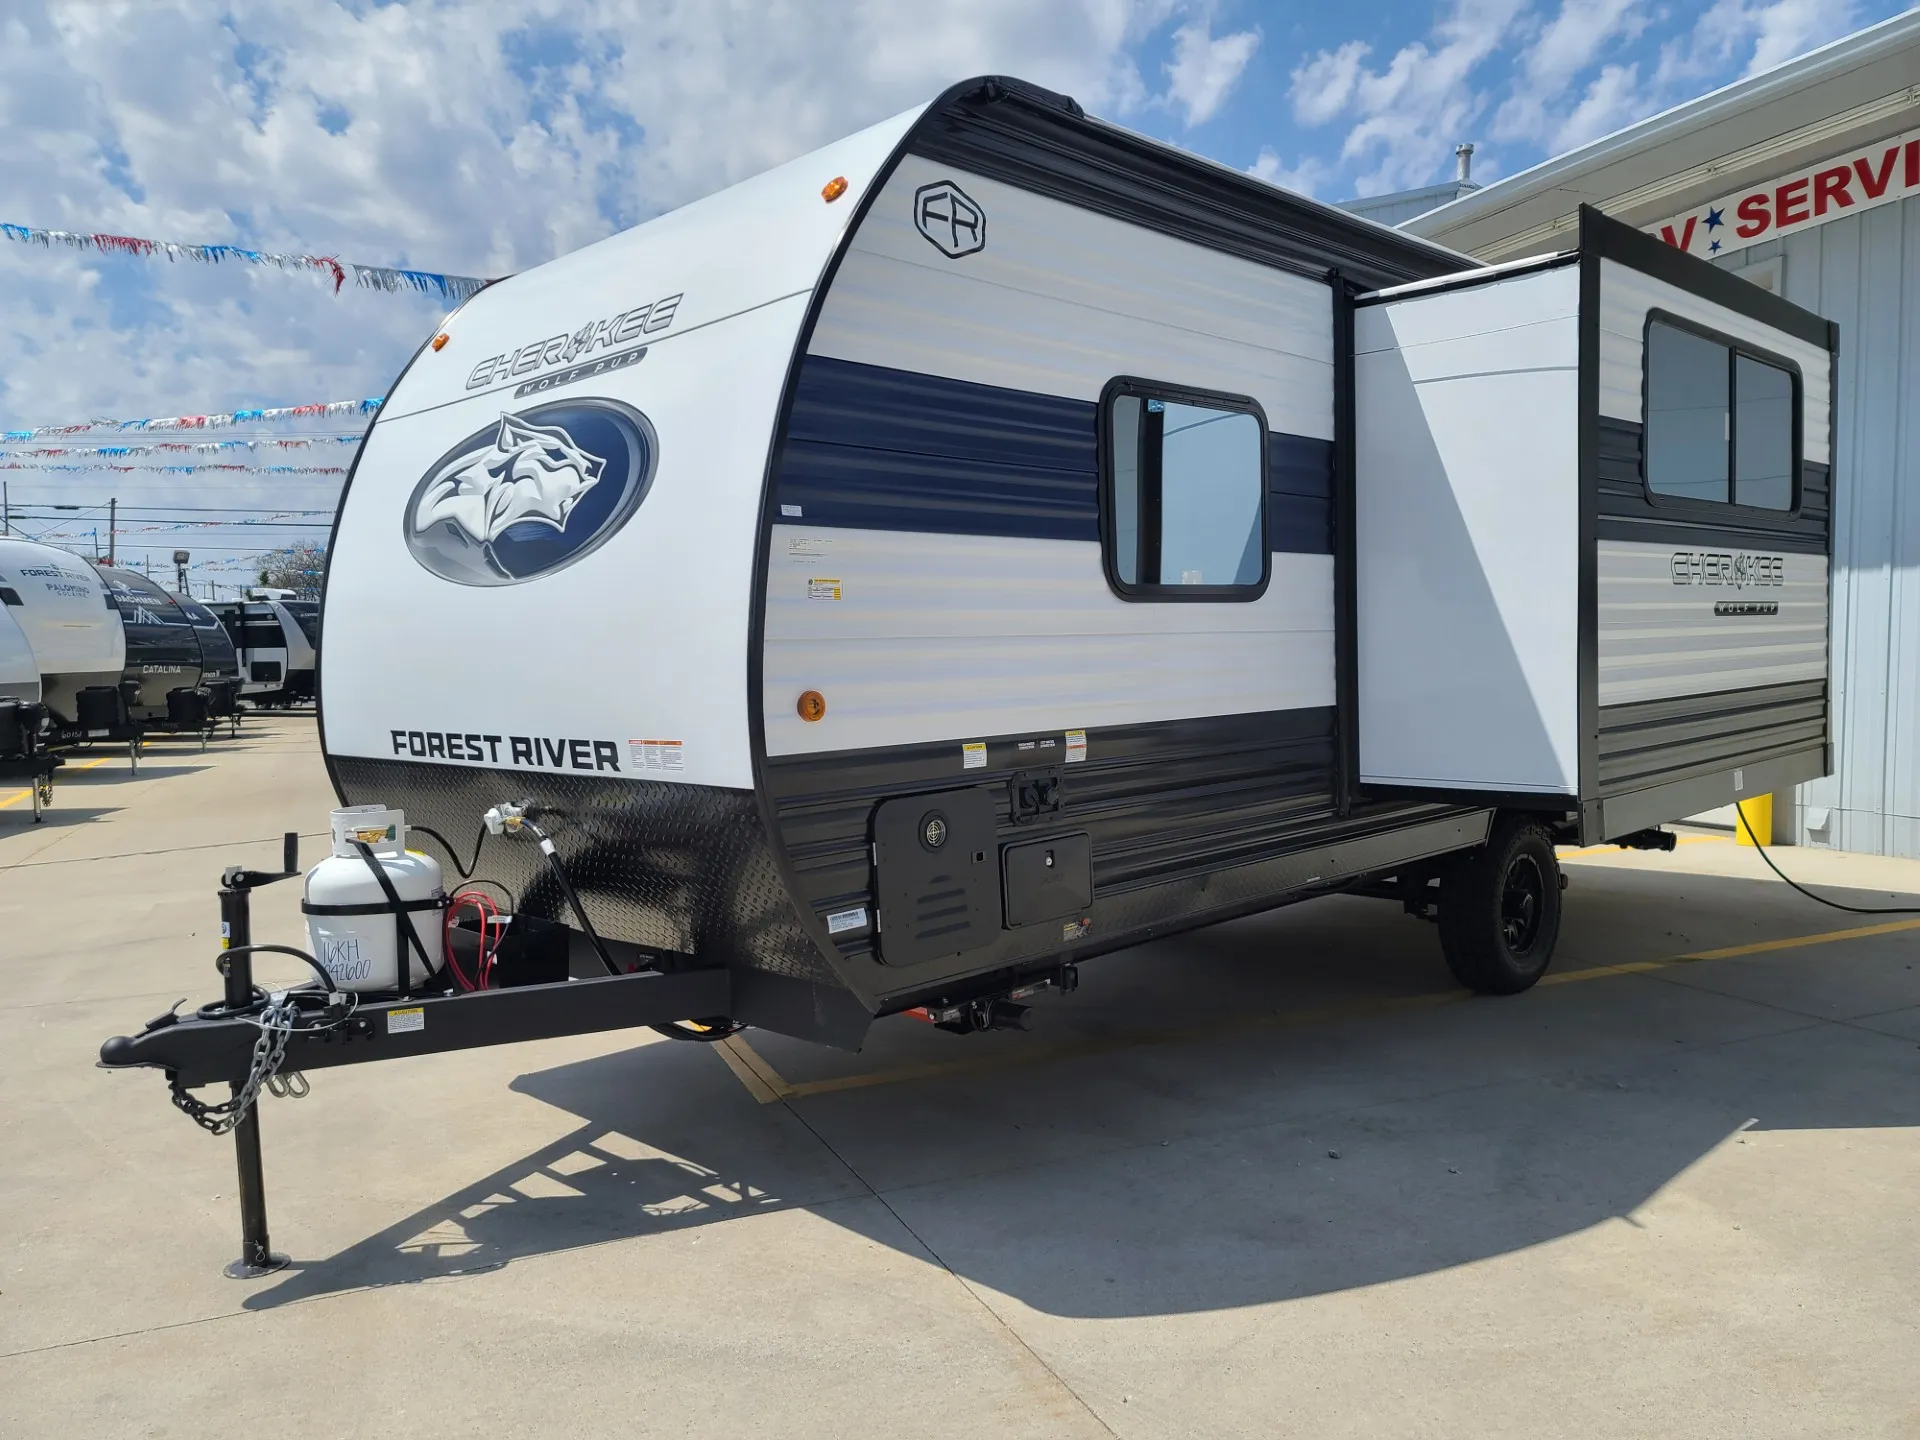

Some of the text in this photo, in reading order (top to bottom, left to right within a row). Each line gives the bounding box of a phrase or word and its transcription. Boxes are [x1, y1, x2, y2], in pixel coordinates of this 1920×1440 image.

[465, 292, 685, 391] CHEROKEE
[522, 351, 639, 395] WOLF PUP
[20, 569, 92, 583] FOREST RIVER
[1670, 551, 1785, 591] CHEROKEE
[45, 582, 91, 595] PALOMINO
[1718, 603, 1775, 613] WOLF PUP
[142, 664, 182, 675] CATALINA
[389, 729, 502, 763] FOREST
[508, 735, 622, 773] RIVER
[322, 938, 360, 965] 16KH
